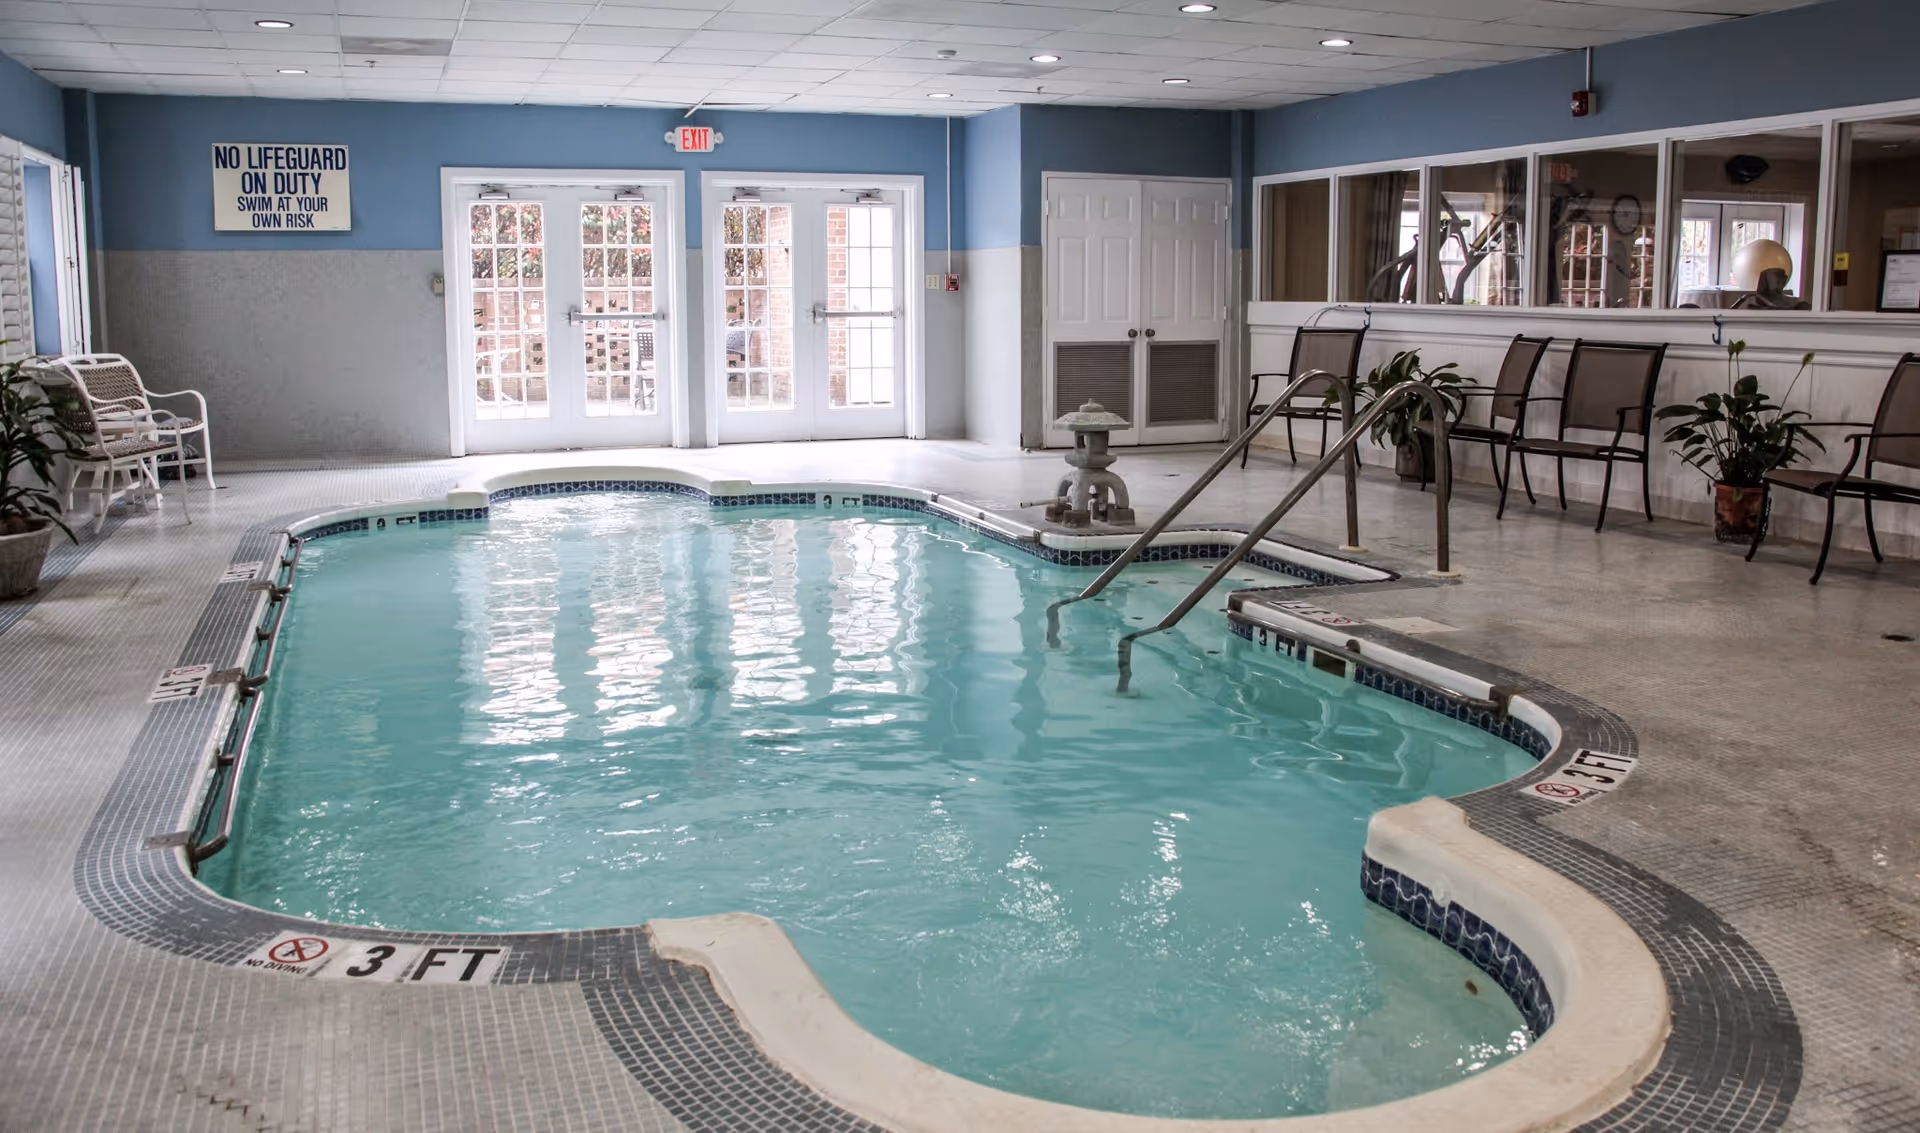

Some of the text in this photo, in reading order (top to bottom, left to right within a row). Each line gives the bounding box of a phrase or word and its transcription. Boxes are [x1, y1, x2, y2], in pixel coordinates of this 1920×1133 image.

[682, 129, 708, 149] EXIT
[215, 146, 346, 170] NO LIFEGUARD
[241, 172, 321, 194] ON DUTY
[238, 197, 328, 211] SWIM AT YOUR
[252, 213, 314, 228] OWN RISK
[1259, 628, 1267, 646] 3
[1574, 750, 1632, 772] FT
[1562, 769, 1615, 784] 3
[243, 959, 307, 974] NO DIVING
[346, 945, 501, 981] 3 FT
